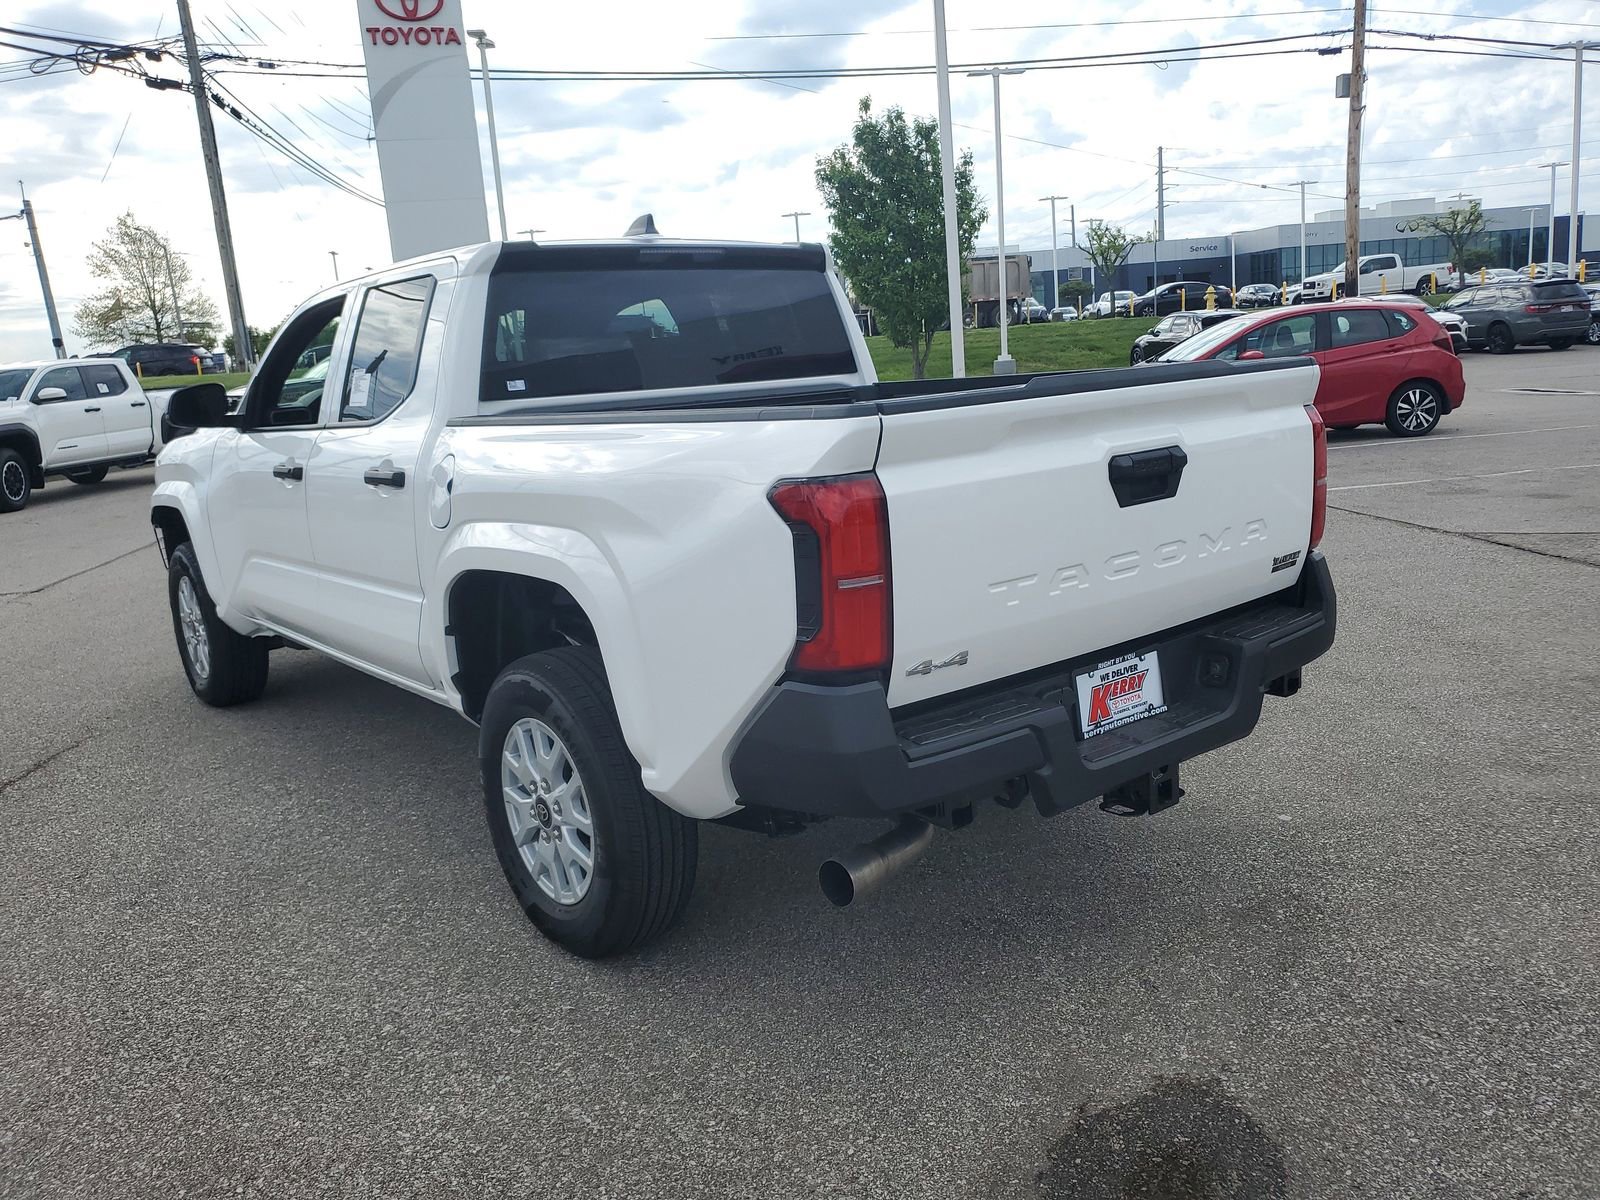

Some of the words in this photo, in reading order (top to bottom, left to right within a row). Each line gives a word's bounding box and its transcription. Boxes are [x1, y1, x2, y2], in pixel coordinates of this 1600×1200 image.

[366, 27, 461, 45] TOYOTA
[1190, 244, 1218, 252] Service
[988, 518, 1267, 605] TACOMA
[1097, 659, 1115, 669] RIGHT
[1115, 656, 1123, 664] BY
[1124, 652, 1136, 662] YOU
[1100, 672, 1110, 682] WE
[1111, 664, 1138, 679] DELIVER
[1088, 669, 1148, 726] KERRY
[1120, 693, 1141, 705] TOYOTA
[1083, 705, 1168, 740] kerryautomotive.com
